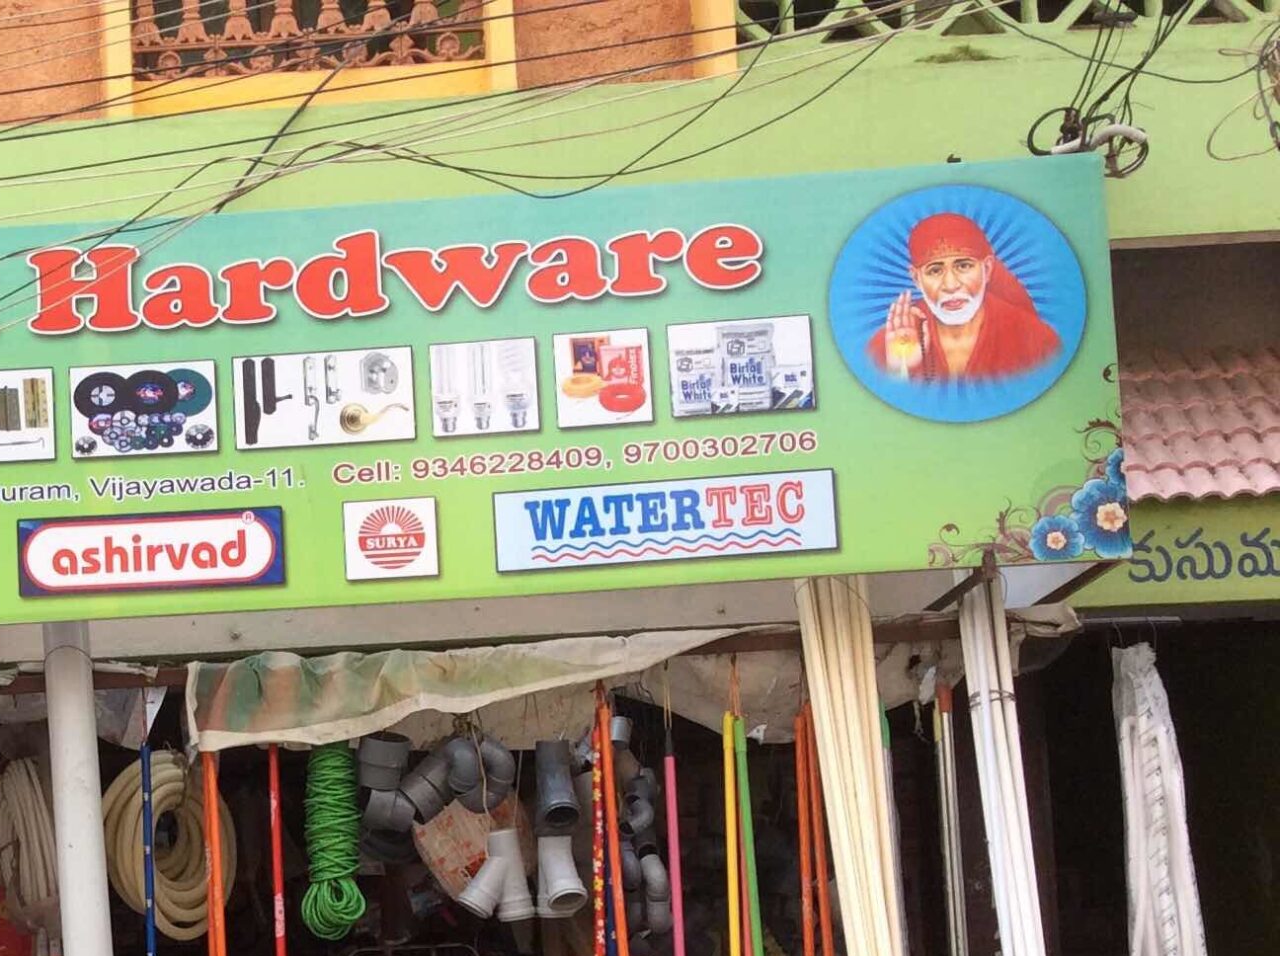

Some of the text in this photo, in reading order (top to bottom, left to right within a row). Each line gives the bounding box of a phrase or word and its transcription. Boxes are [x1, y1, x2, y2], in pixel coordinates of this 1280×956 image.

[27, 222, 763, 336] Hardware
[731, 372, 765, 385] White
[90, 467, 305, 500] Vijayawada-11.
[332, 461, 402, 485] Cell:
[412, 446, 612, 479] 9346228409,
[623, 431, 817, 465] 9700302706
[524, 481, 805, 541] WATERTEC
[51, 529, 247, 576] ashirvad
[365, 534, 419, 550] SURYA
